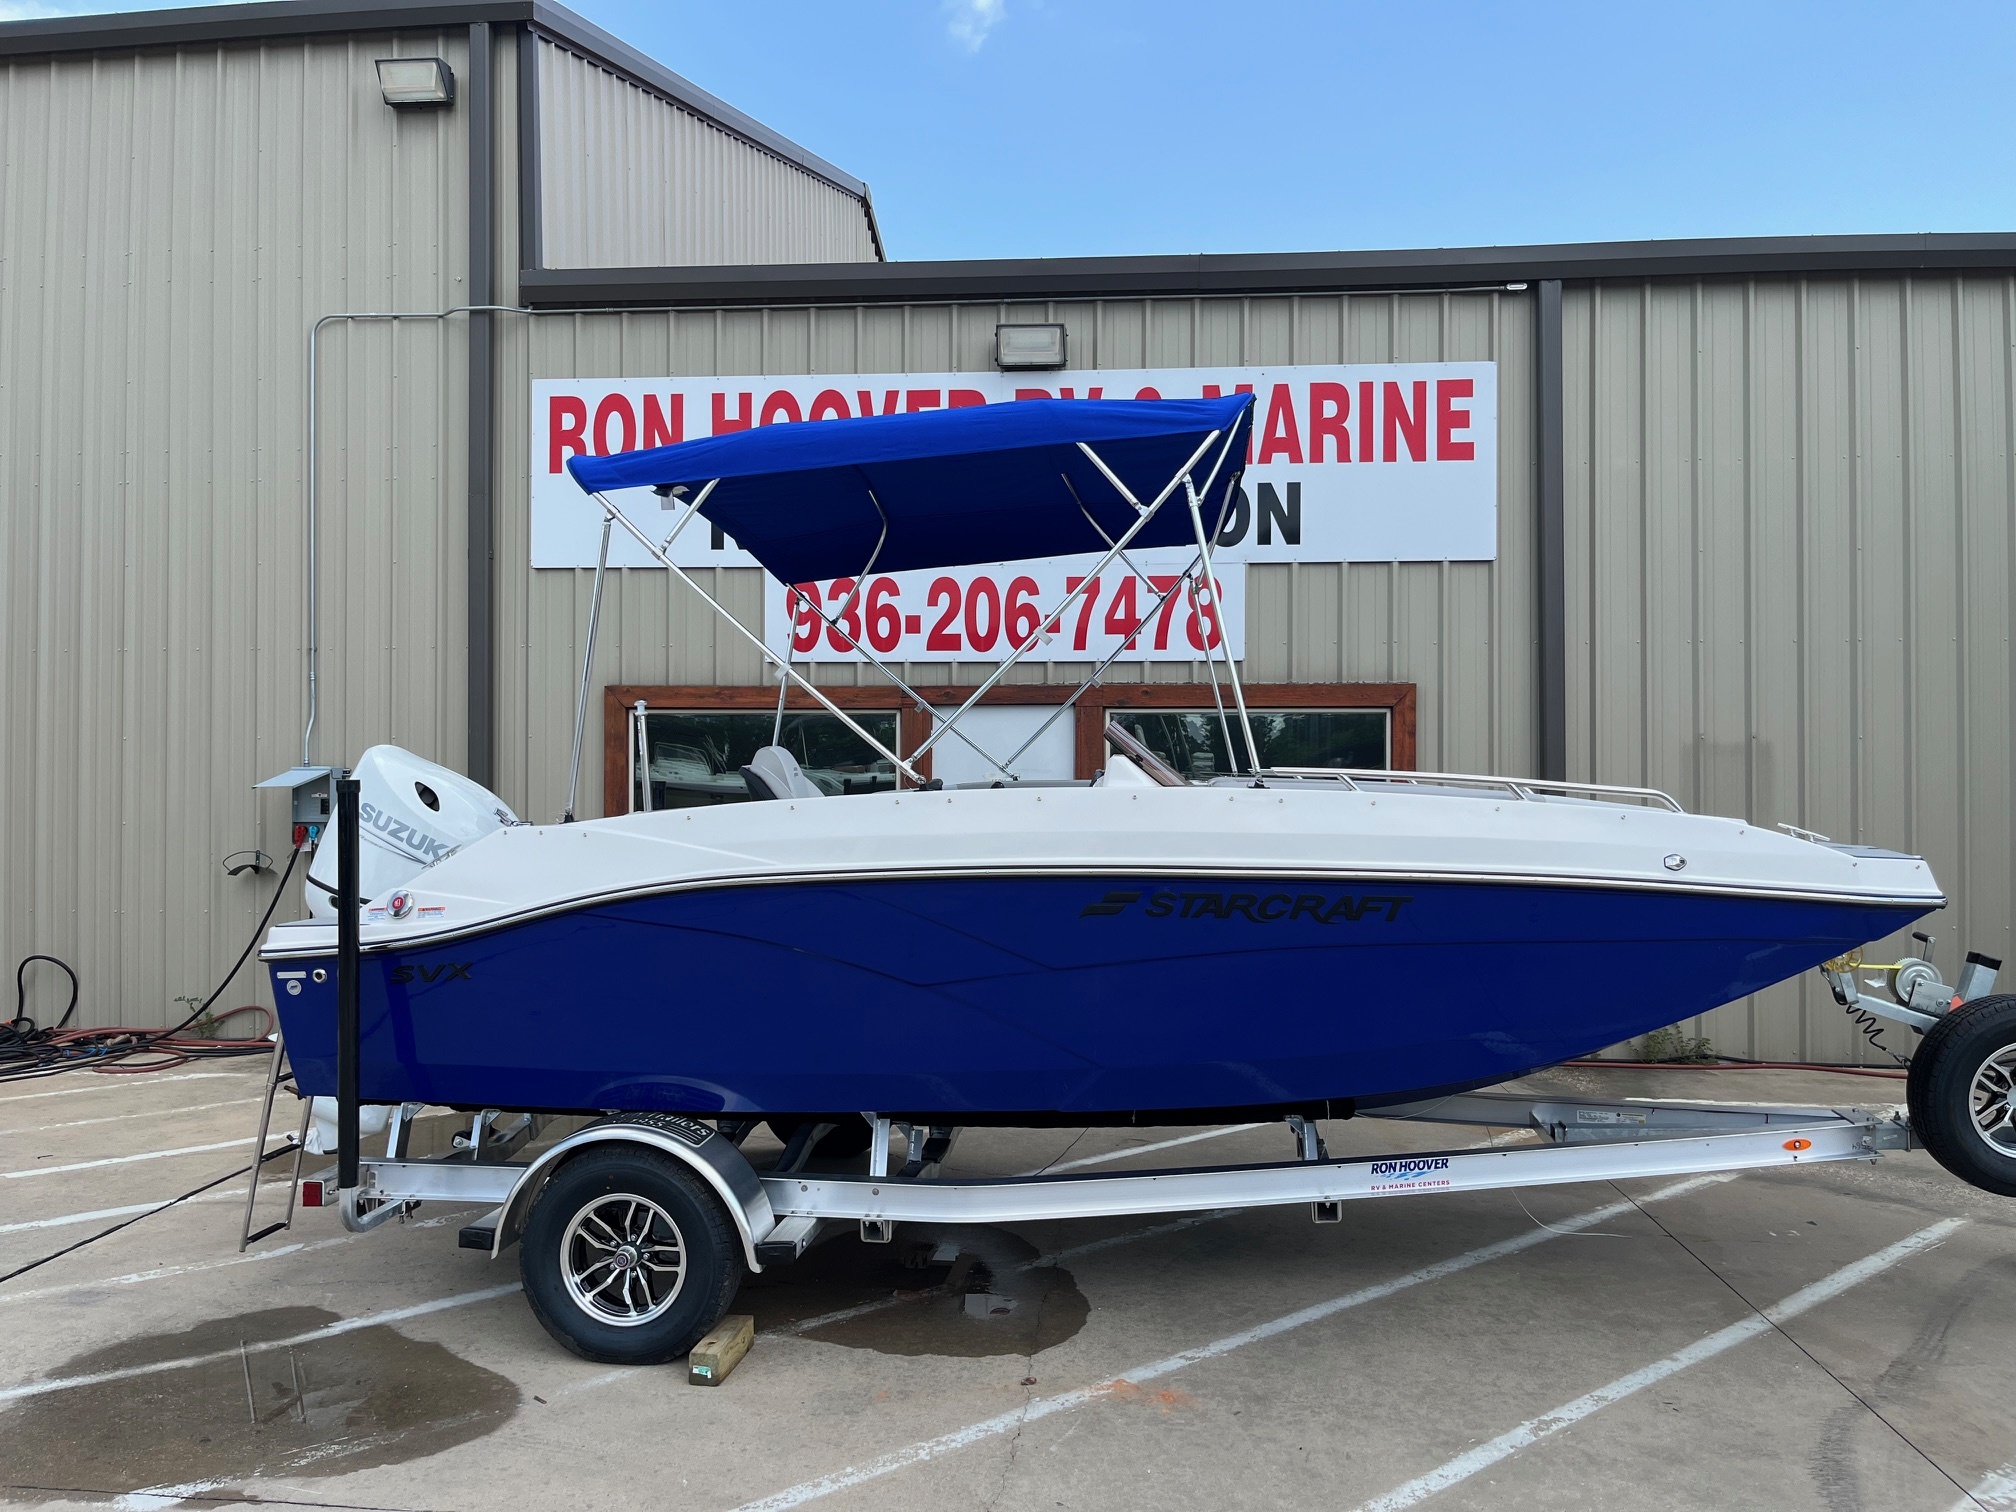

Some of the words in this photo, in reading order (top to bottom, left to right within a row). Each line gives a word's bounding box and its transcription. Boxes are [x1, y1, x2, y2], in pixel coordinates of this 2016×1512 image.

[549, 392, 684, 474] RON
[1202, 378, 1475, 465] ARINE
[786, 575, 1223, 653] 936-206-7478
[359, 802, 450, 861] SUZUK
[1145, 891, 1415, 925] STARCRAFT
[389, 962, 474, 984] SVX
[1371, 1162, 1397, 1174] RON
[1399, 1158, 1449, 1172] HOOVER
[1388, 1182, 1416, 1190] MARINE
[1418, 1179, 1450, 1188] CENTERS
